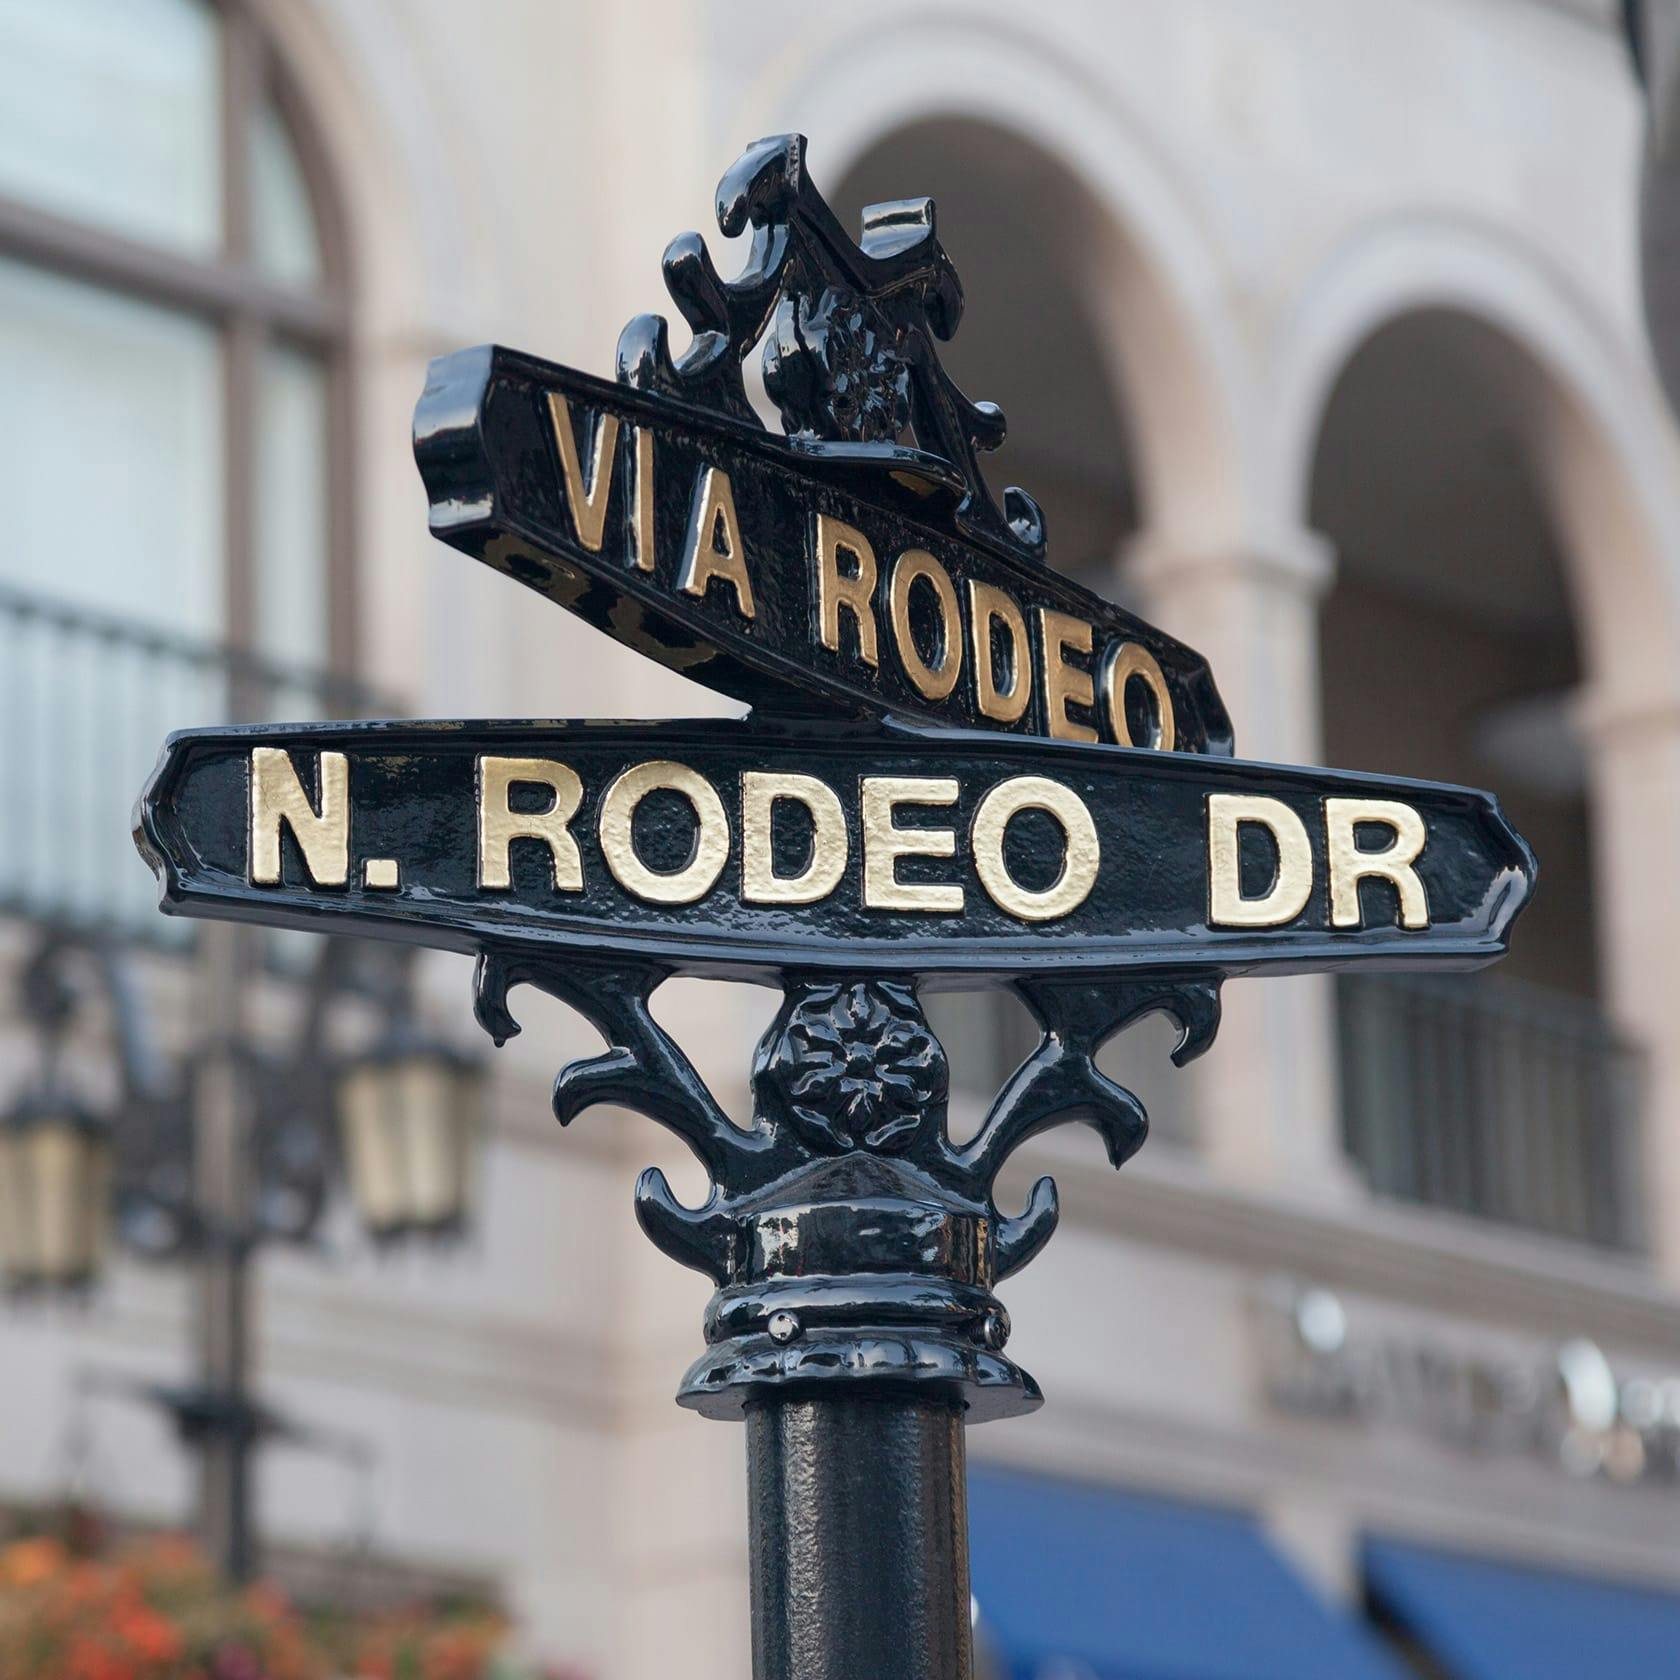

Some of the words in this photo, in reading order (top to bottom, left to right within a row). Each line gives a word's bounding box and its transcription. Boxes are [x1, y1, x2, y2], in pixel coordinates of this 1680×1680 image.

[545, 391, 756, 620] VIA
[814, 512, 1177, 752] RODEO
[249, 746, 399, 889] N.
[477, 755, 1101, 922] RODEO
[1207, 793, 1430, 930] DR
